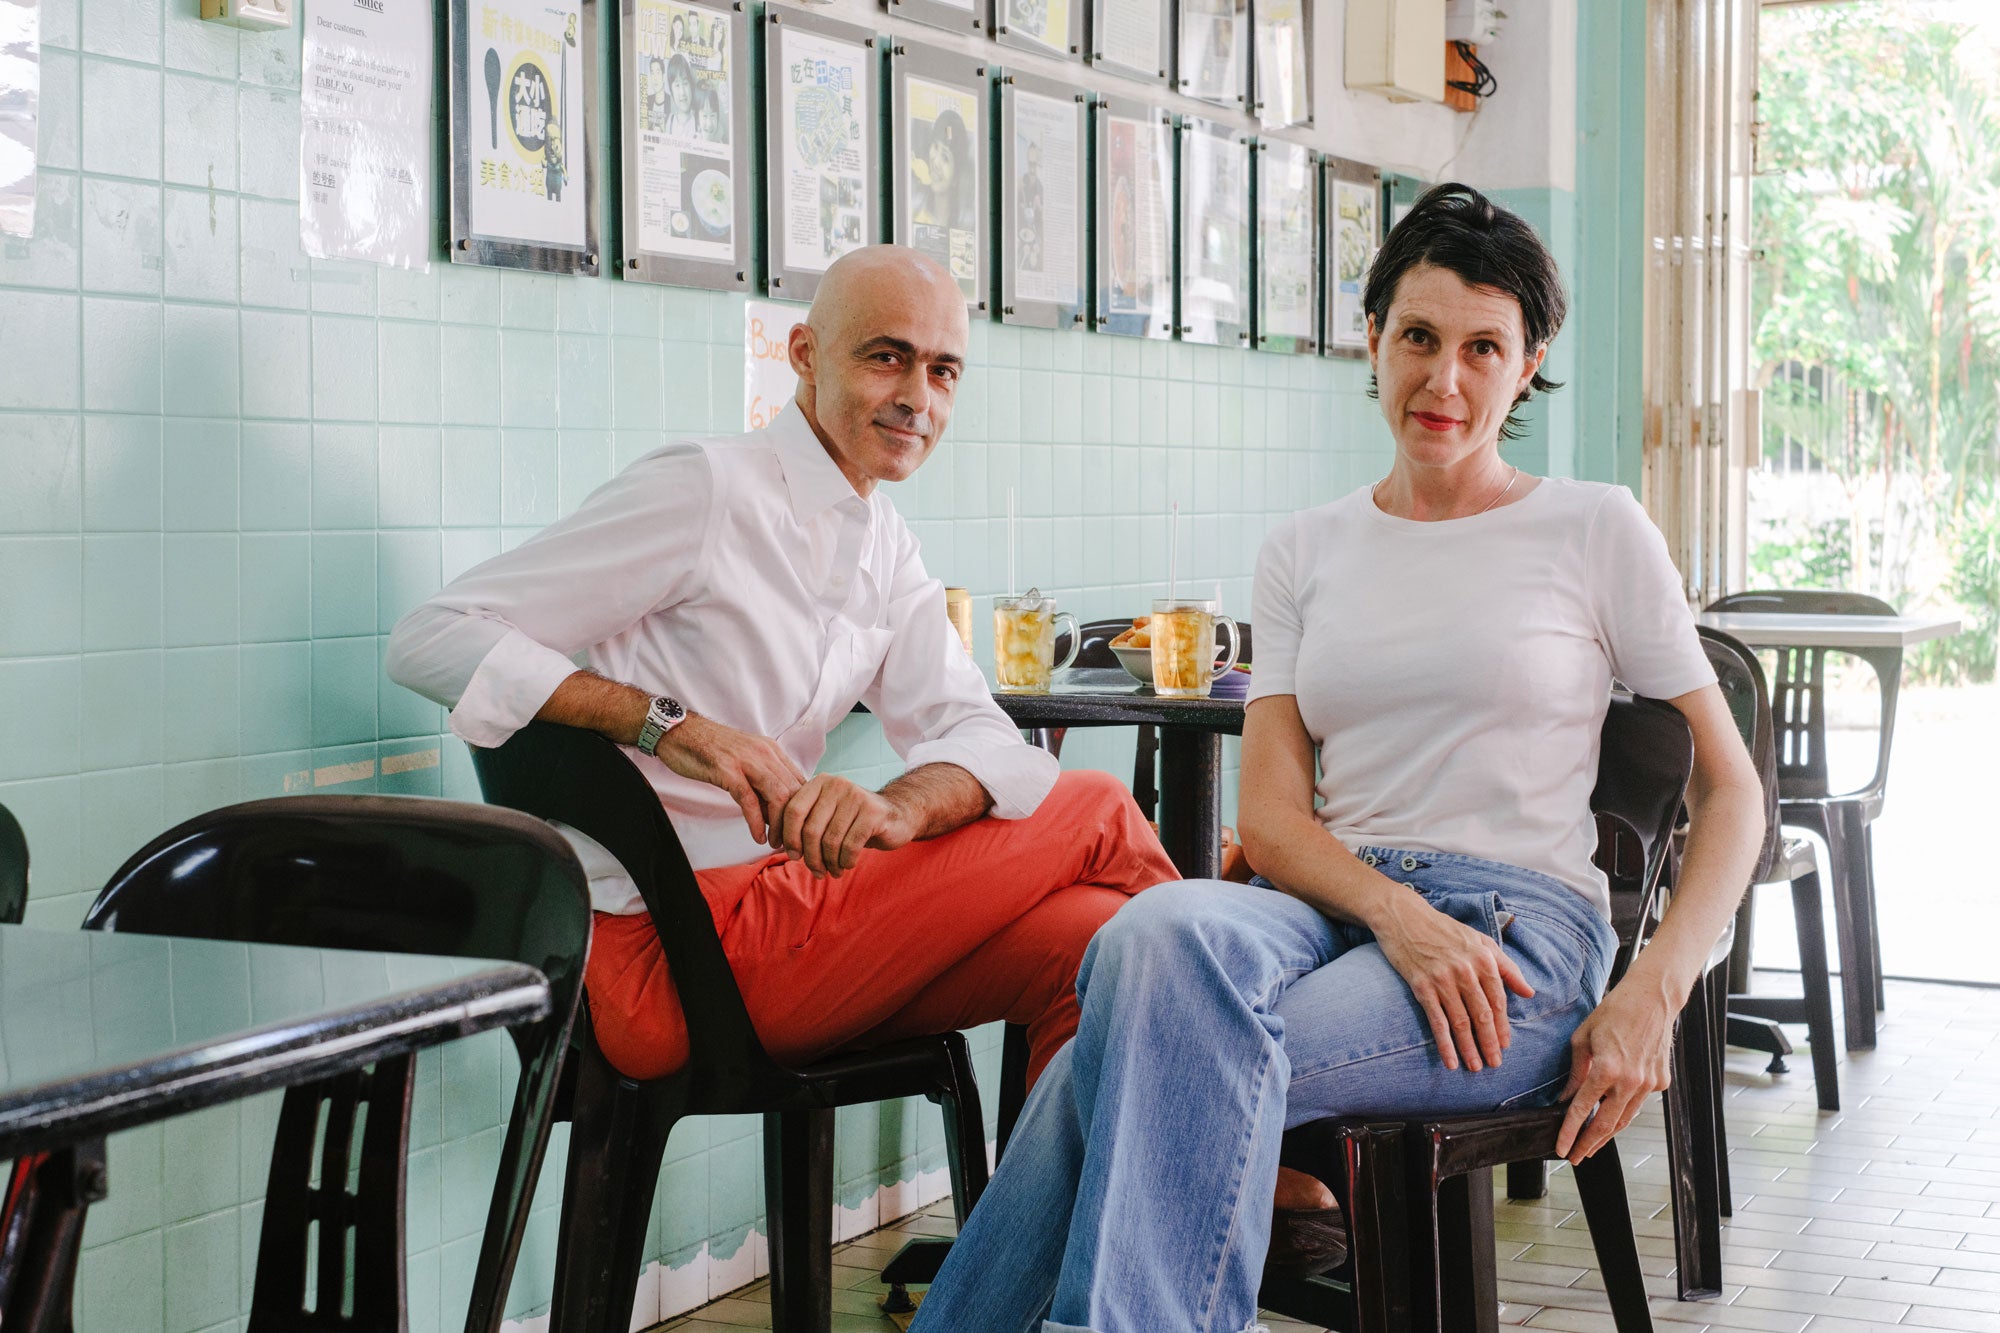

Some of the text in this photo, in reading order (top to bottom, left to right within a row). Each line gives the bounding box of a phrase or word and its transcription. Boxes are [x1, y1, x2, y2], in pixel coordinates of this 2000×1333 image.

[316, 16, 332, 28] Dear
[514, 71, 546, 108] 大小
[515, 103, 547, 141] 通吃
[480, 157, 545, 197] 美食介绍
